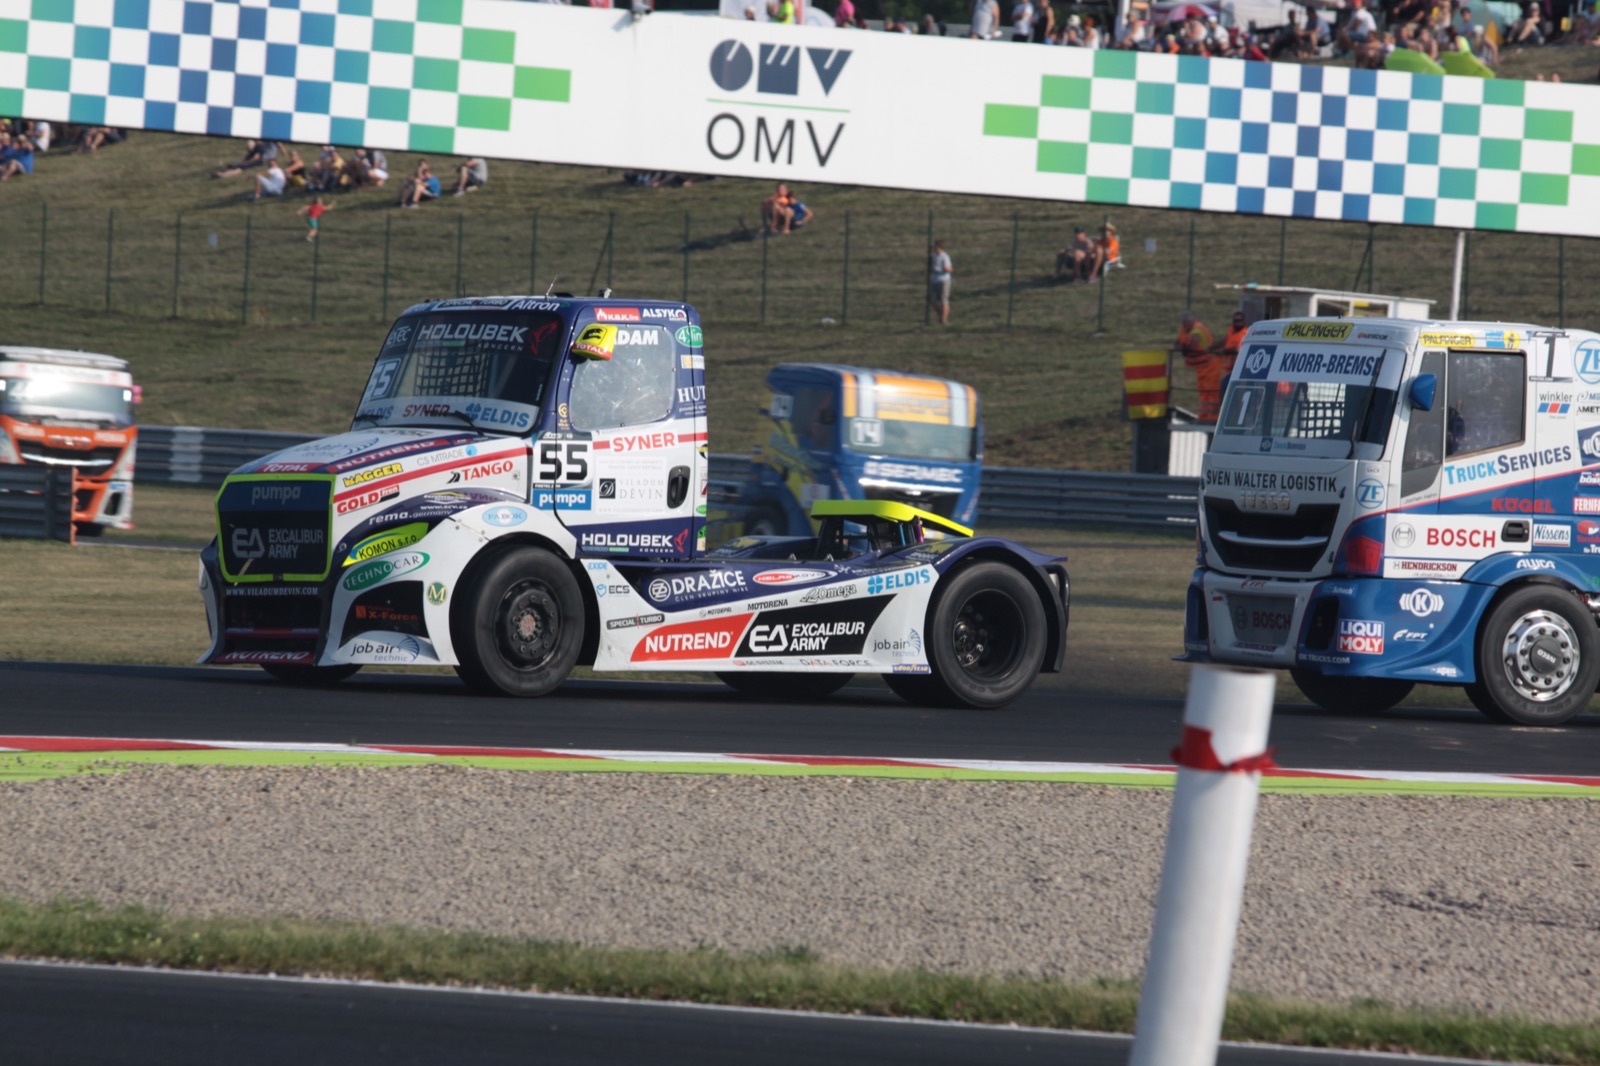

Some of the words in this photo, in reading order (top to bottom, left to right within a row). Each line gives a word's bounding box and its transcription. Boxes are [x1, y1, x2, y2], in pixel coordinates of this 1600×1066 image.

[706, 112, 846, 168] OMV
[511, 299, 561, 313] Altron
[417, 323, 529, 344] HOLOUBEK
[1287, 323, 1348, 339] PALFINGER
[1422, 334, 1473, 346] PALFINGER
[1544, 335, 1556, 378] 1
[1540, 390, 1573, 402] winkler
[1236, 390, 1251, 426] 1
[480, 408, 530, 428] ELDIS
[853, 421, 882, 445] 14
[612, 432, 676, 453] SYNER
[263, 464, 309, 472] TOTAL
[462, 460, 514, 481] TANGO
[539, 443, 588, 481] 55
[1207, 469, 1231, 486] SVEN
[1234, 472, 1277, 489] WALTER
[1281, 474, 1338, 493] LOGISTIK
[251, 485, 302, 505] pumpa
[336, 491, 380, 514] GOLD
[539, 492, 586, 507] pumpa
[1492, 498, 1556, 514] KÖGEL
[268, 529, 324, 544] EXCALIBUR
[581, 533, 673, 547] HOLOUBEK
[1427, 528, 1496, 548] BOSCH
[1534, 525, 1570, 540] Nissens
[268, 544, 299, 559] ARMY
[358, 538, 397, 560] KOMON
[345, 554, 421, 589] TECHNOCAR
[1402, 562, 1458, 572] HENDRICKSON
[671, 569, 747, 595] DRAŽICE
[885, 568, 932, 591] ELDIS
[608, 585, 630, 594] ECS
[747, 598, 789, 611] MOTORENA
[610, 620, 637, 629] SPECIAL
[640, 615, 663, 625] TURBO
[1253, 611, 1291, 630] BOSCH
[1340, 620, 1383, 637] LIQUI
[791, 622, 866, 638] EXCALIBUR
[351, 642, 374, 656] job
[375, 645, 395, 653] air
[645, 630, 732, 654] NUTREND
[789, 636, 830, 652] ARMY
[873, 639, 891, 652] job
[892, 641, 909, 650] air
[1338, 637, 1384, 655] MOLY
[374, 654, 409, 662] technic
